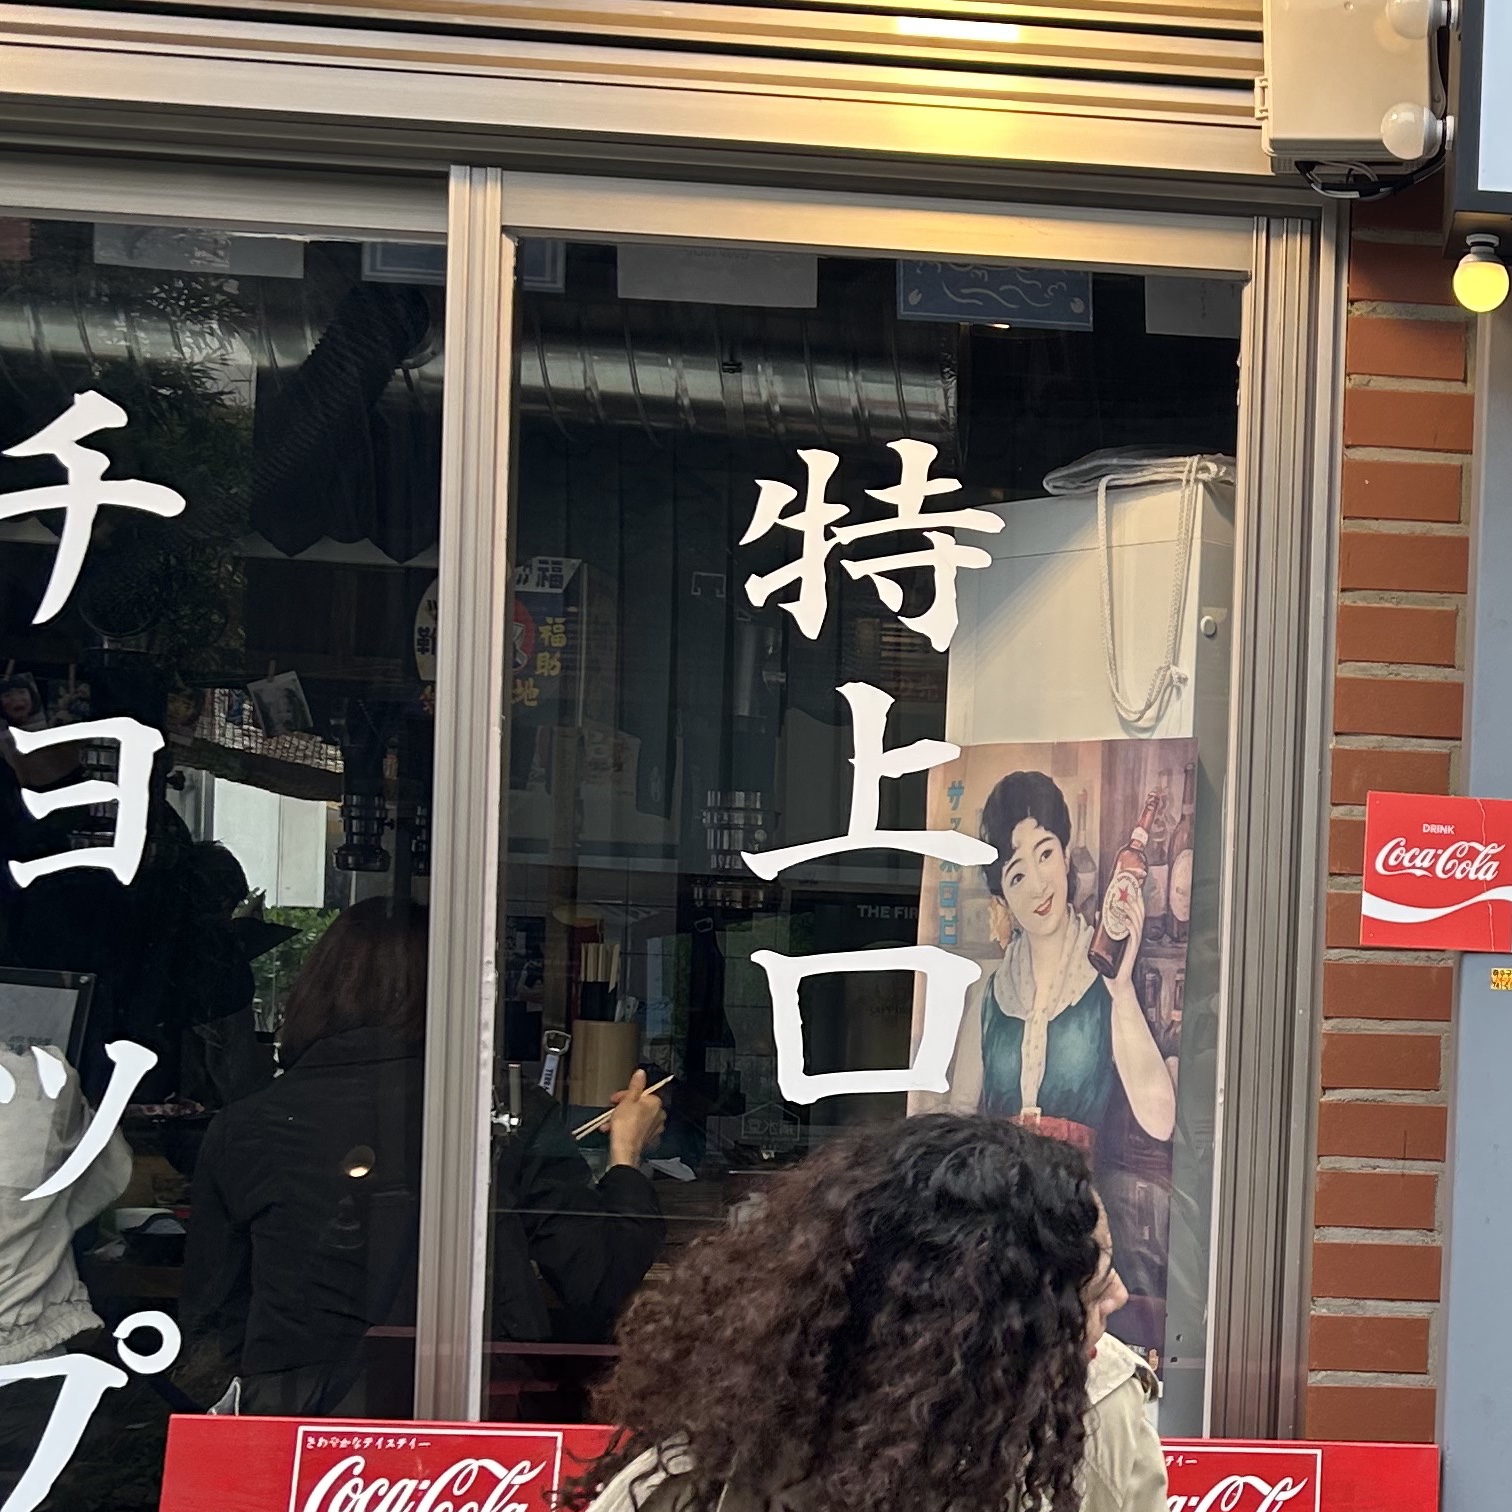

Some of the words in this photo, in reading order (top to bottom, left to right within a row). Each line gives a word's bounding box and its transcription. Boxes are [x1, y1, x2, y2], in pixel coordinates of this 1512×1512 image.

[1422, 822, 1456, 836] DRINK
[1374, 837, 1506, 883] Coca-Cola
[856, 904, 891, 919] THE
